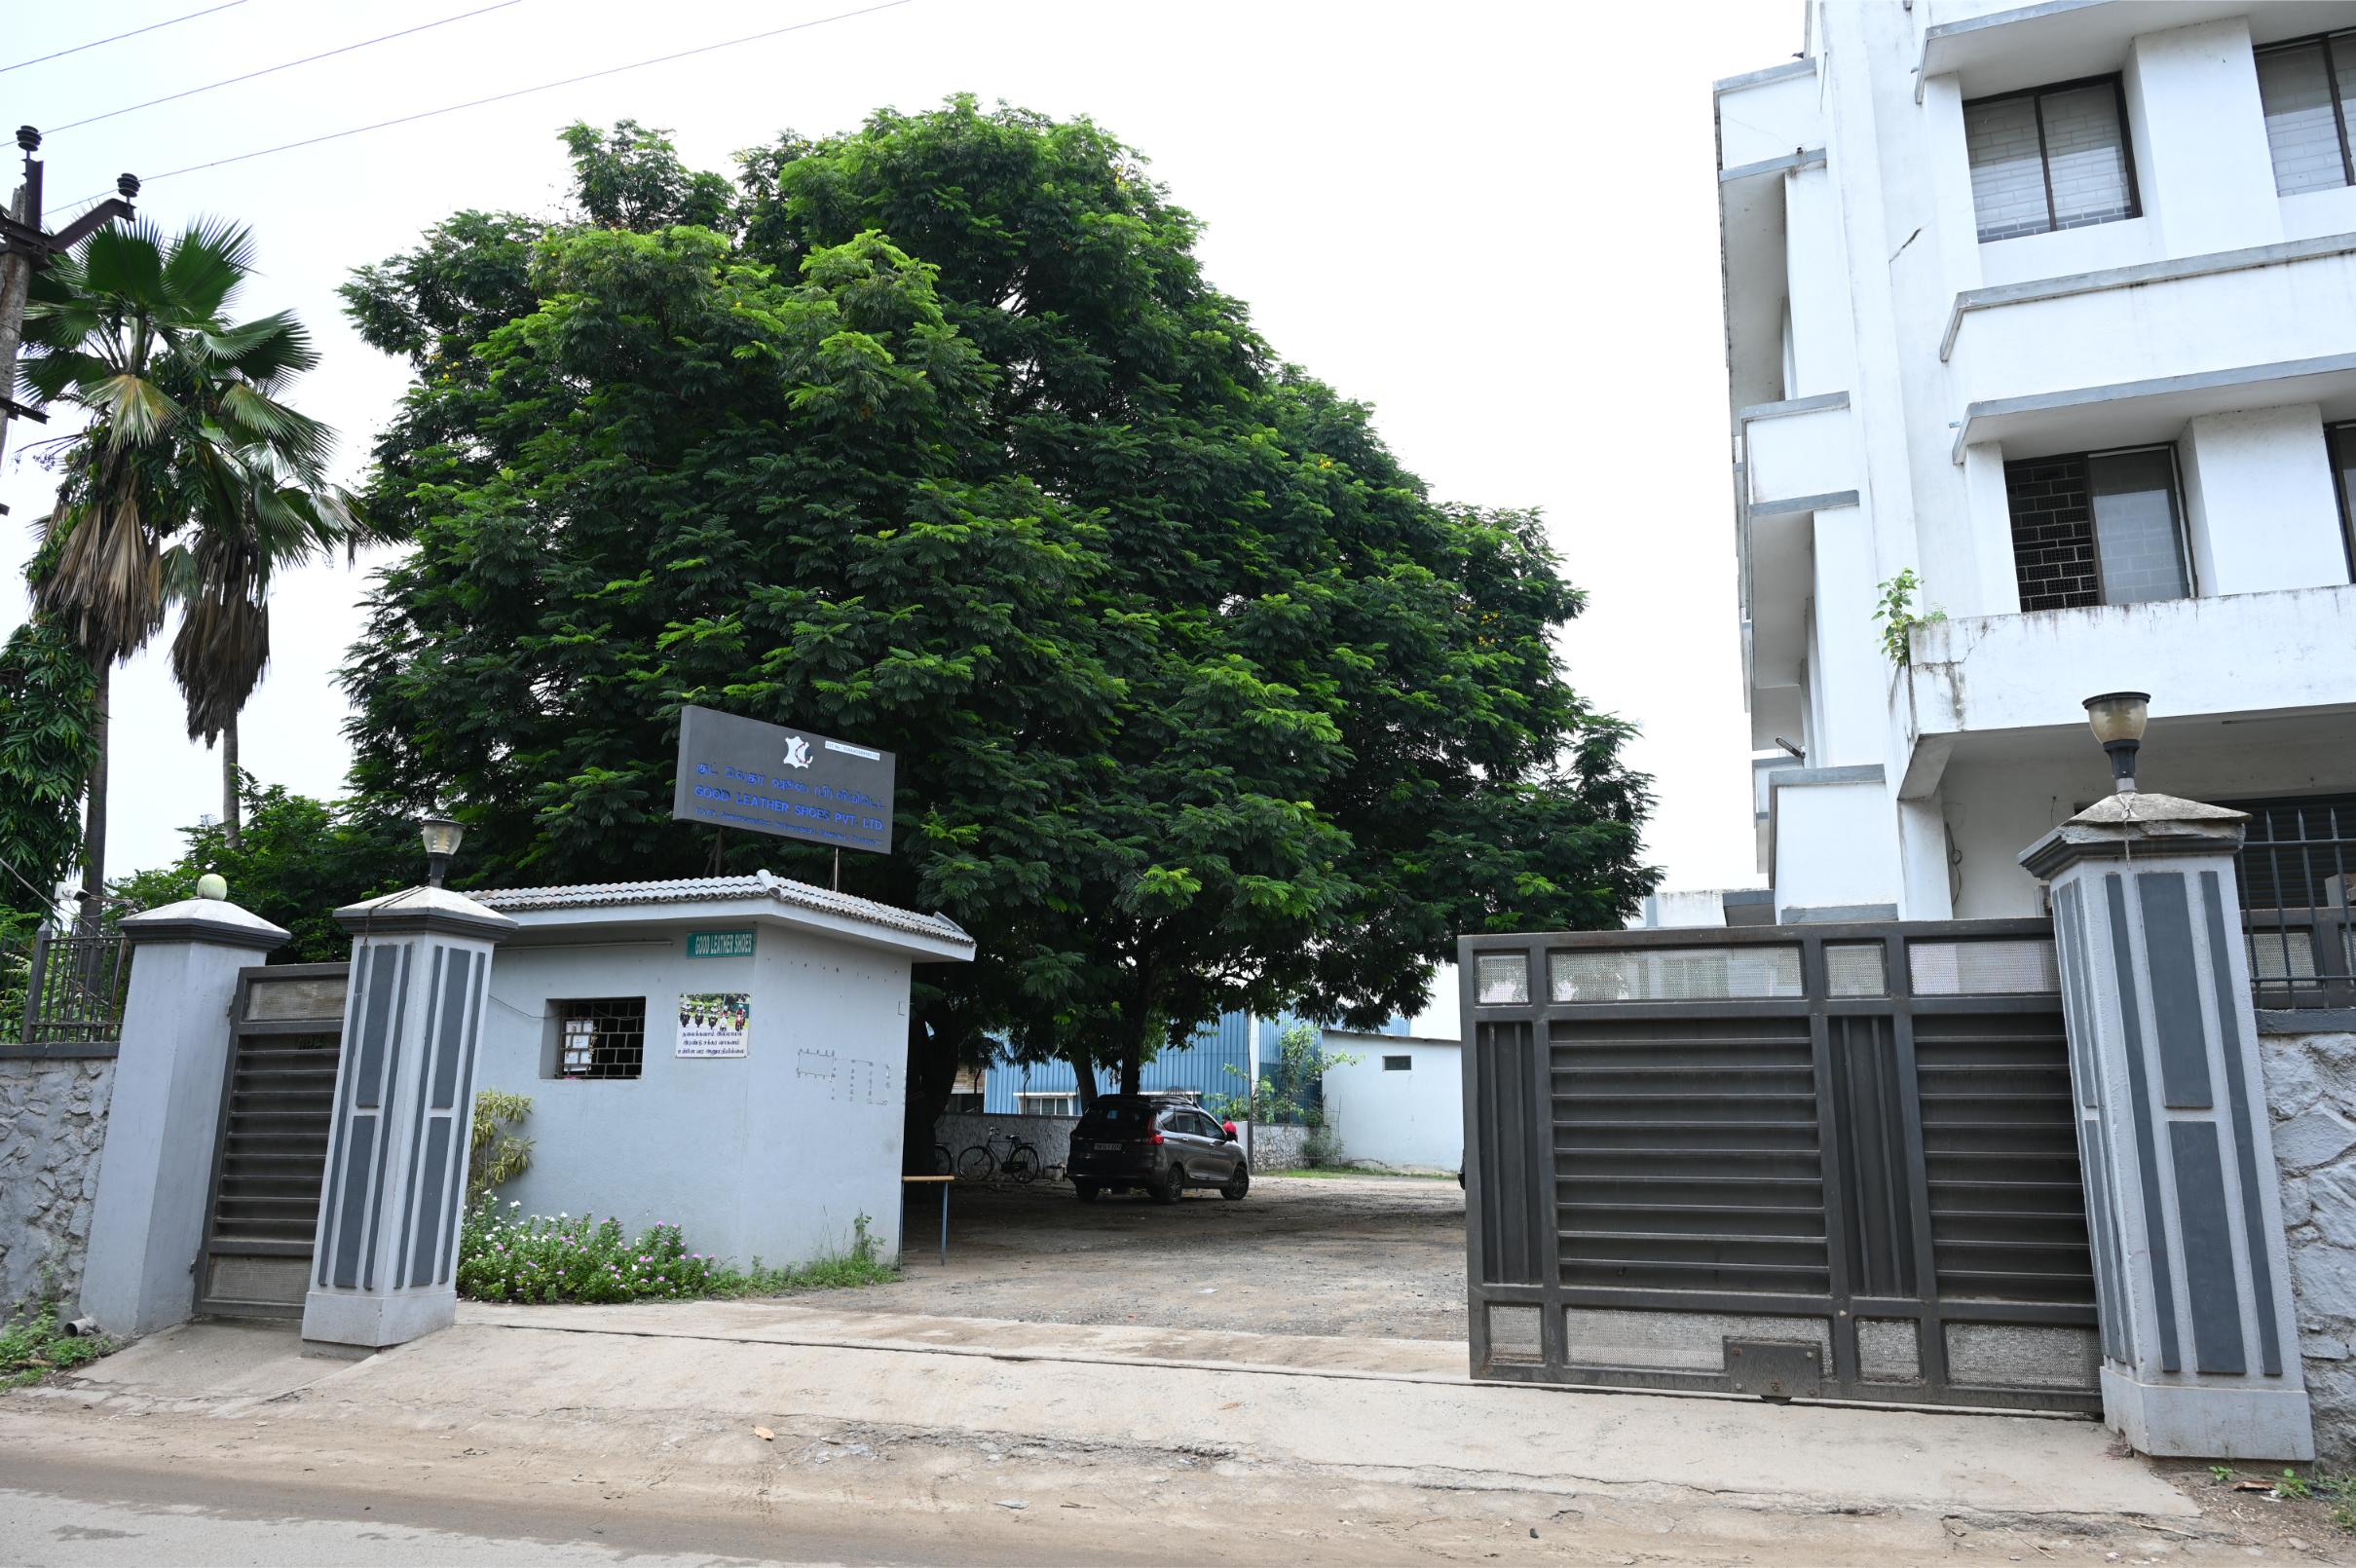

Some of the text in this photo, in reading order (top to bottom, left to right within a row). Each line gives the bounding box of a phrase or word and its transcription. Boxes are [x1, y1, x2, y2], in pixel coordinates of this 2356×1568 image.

[694, 785, 731, 803] GOOD
[735, 791, 790, 812] LEATHER
[795, 803, 831, 821] SHOES
[695, 934, 752, 954] GOOD LEATHER SHOES
